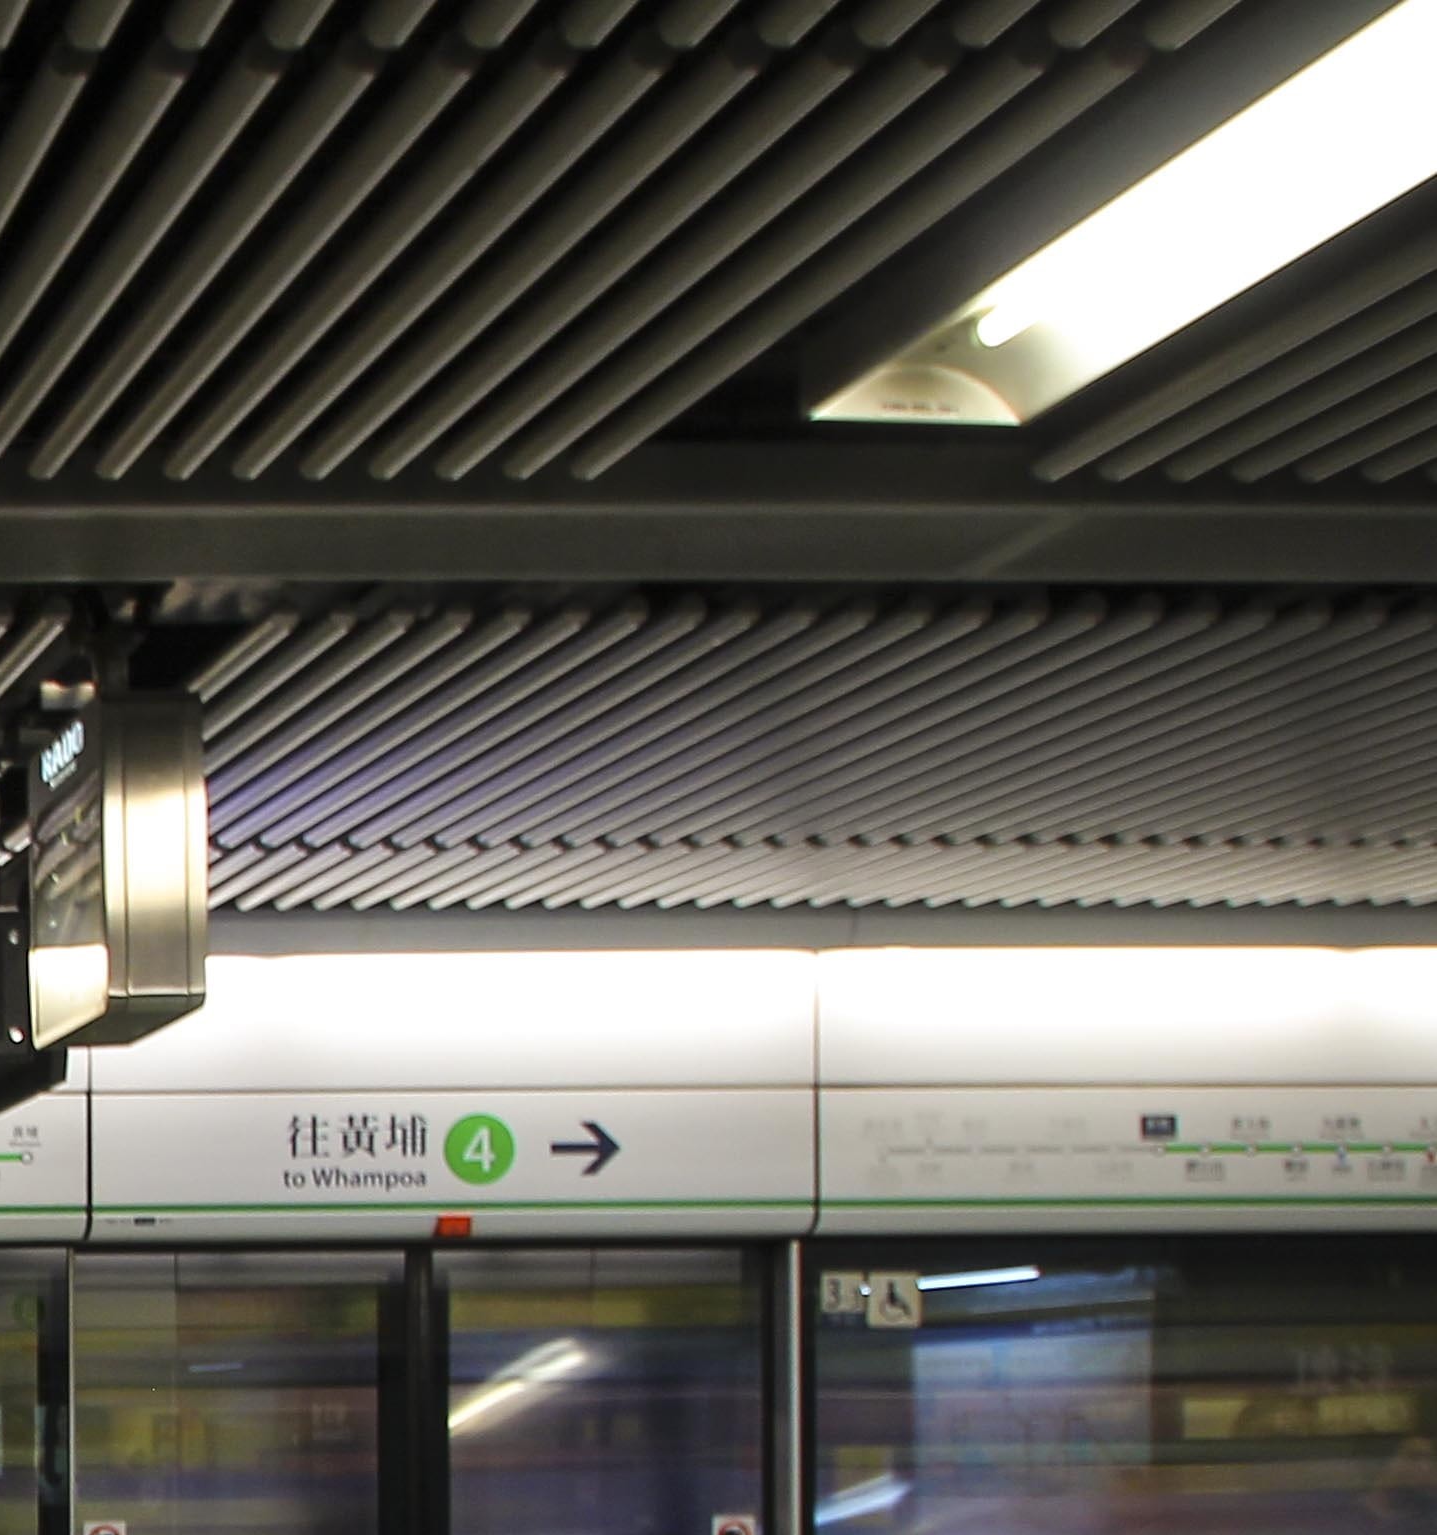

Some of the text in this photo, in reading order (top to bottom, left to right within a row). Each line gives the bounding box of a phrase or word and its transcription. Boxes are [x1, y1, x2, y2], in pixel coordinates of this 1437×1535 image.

[461, 1125, 497, 1175] 4
[283, 1167, 427, 1191] to Whampoa
